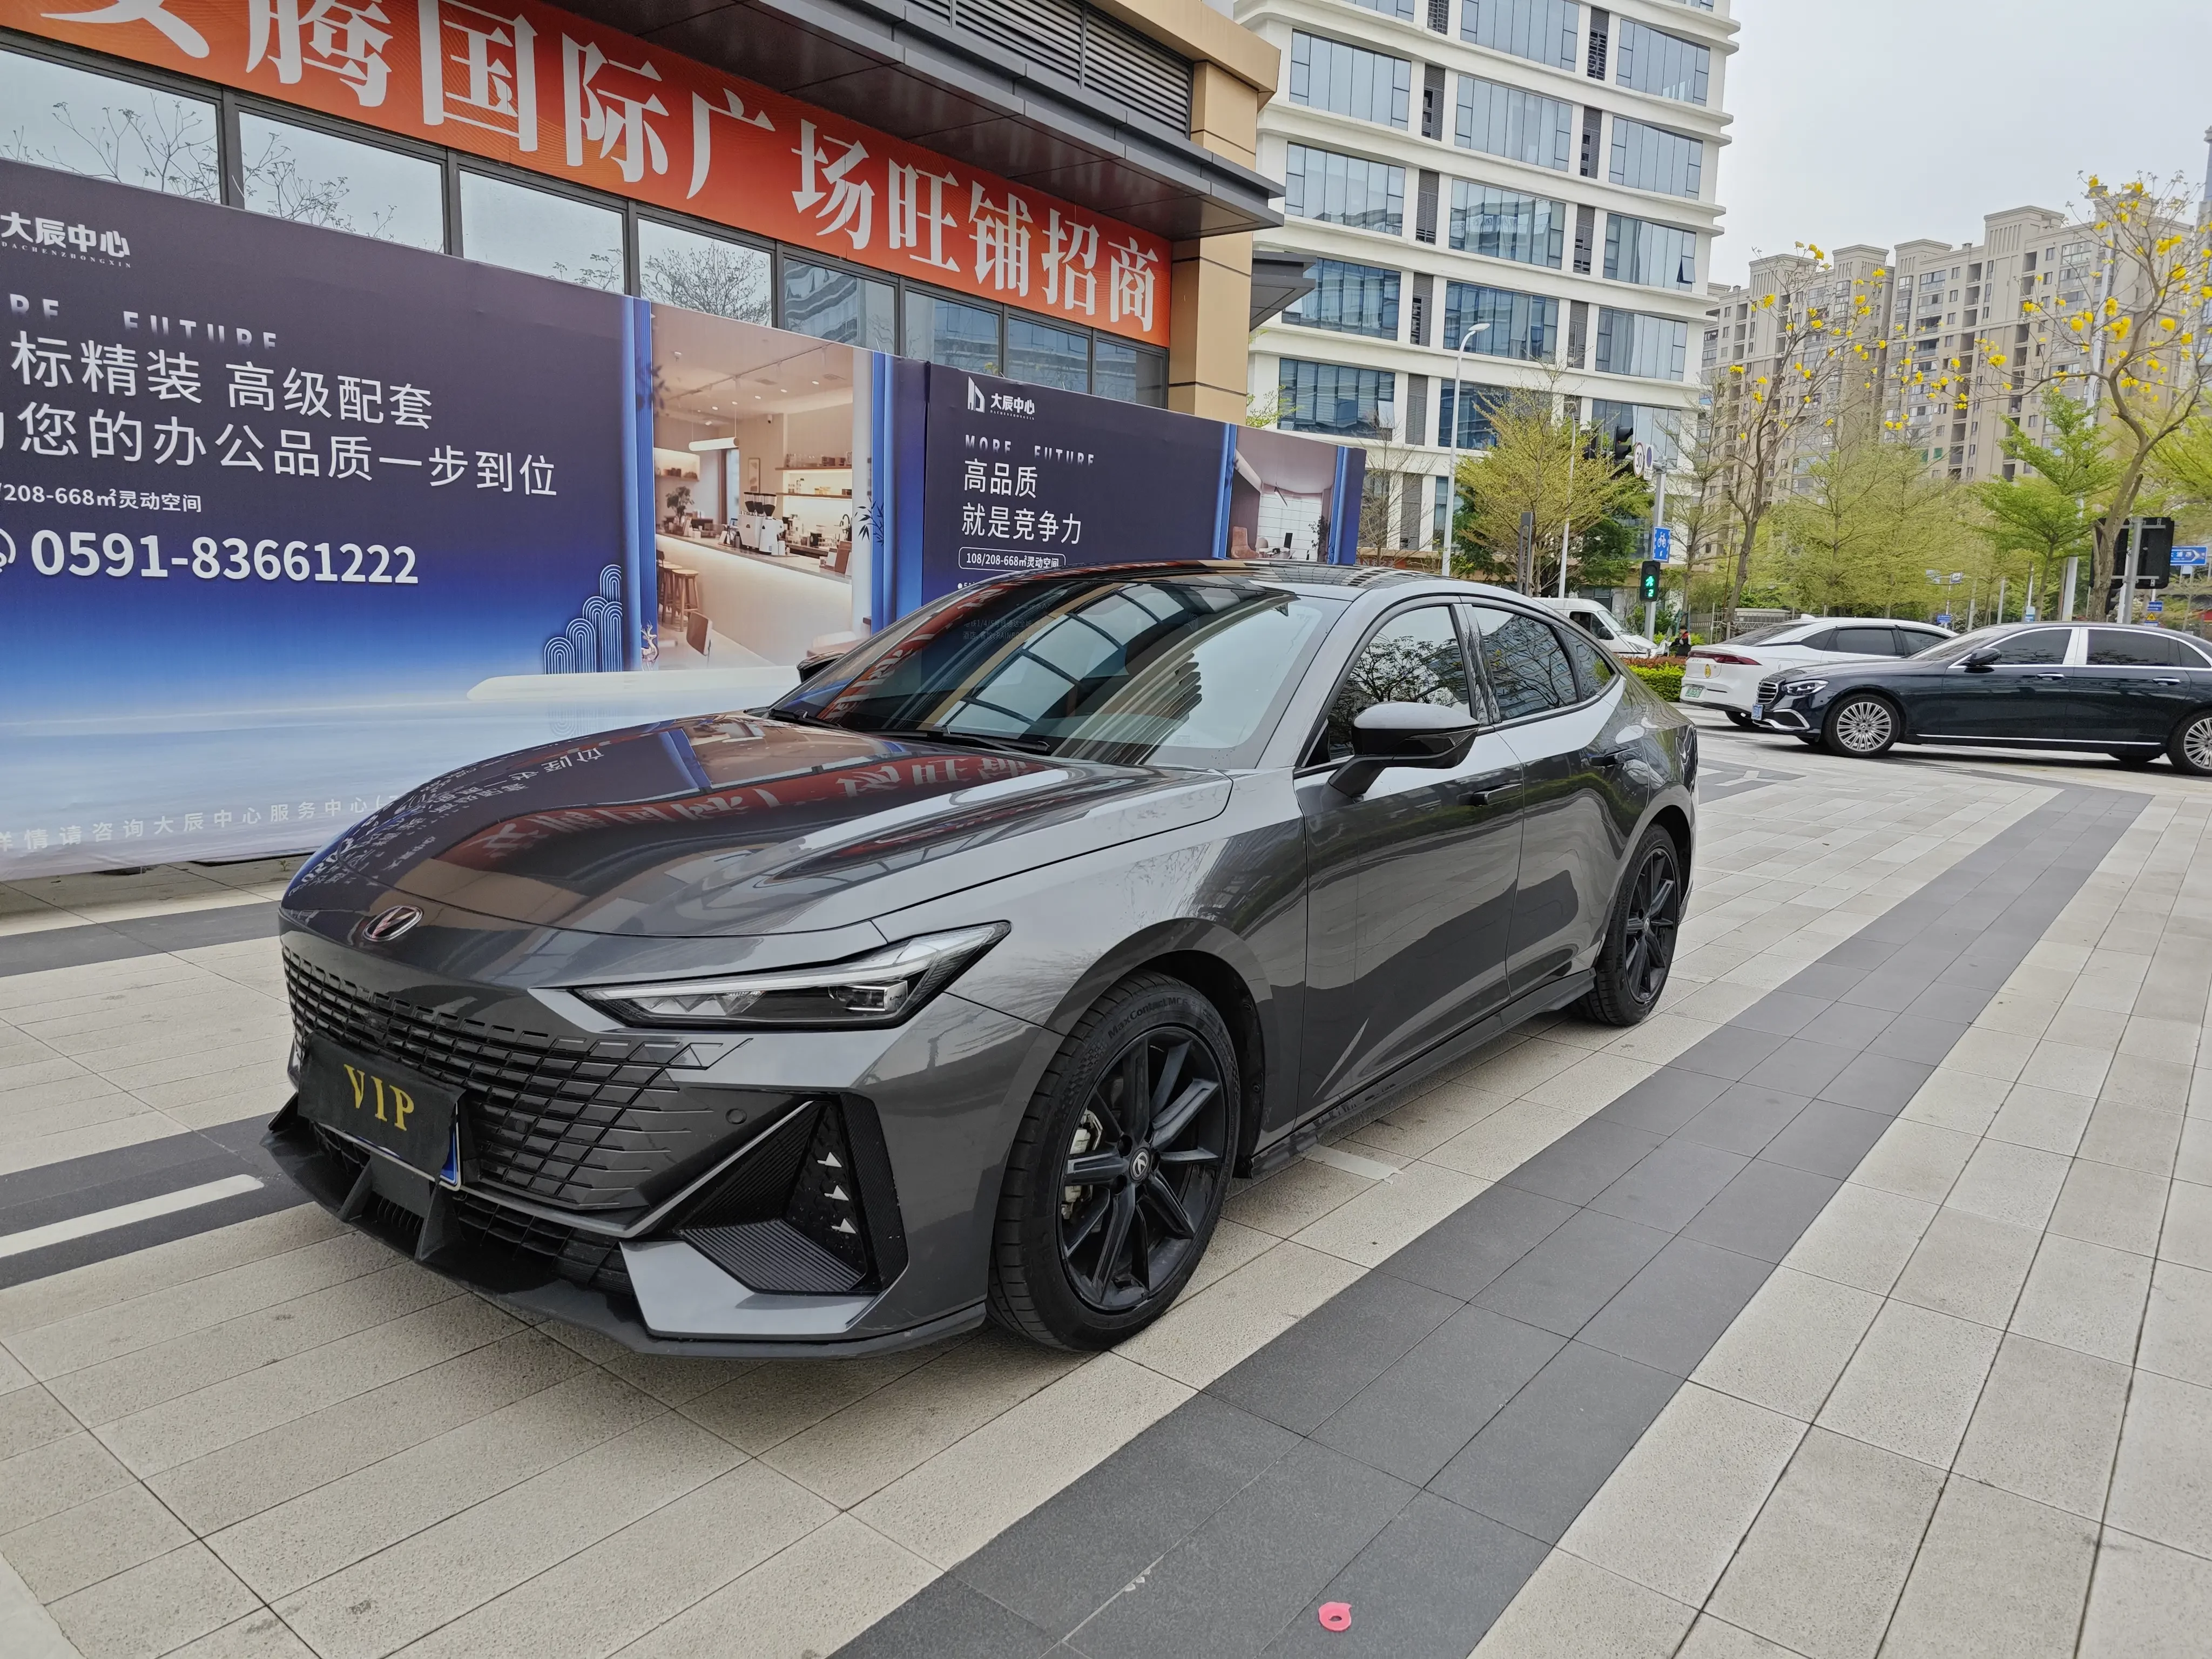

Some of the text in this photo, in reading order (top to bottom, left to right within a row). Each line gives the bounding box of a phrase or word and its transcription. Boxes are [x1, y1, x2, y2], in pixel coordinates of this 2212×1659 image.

[0, 212, 131, 258] 大辰中心
[1, 241, 131, 268] DACHENZHONGXIN
[10, 331, 433, 429] 标精装 高级配套
[990, 393, 1035, 415] 大辰中心
[0, 401, 557, 496] 您的办公品质一步到位
[1636, 451, 1642, 468] 30
[964, 458, 1038, 498] 高品质
[961, 502, 1082, 545] 就是竞争力
[31, 530, 419, 584] 0591-83661222
[343, 1063, 415, 1131] VIP
